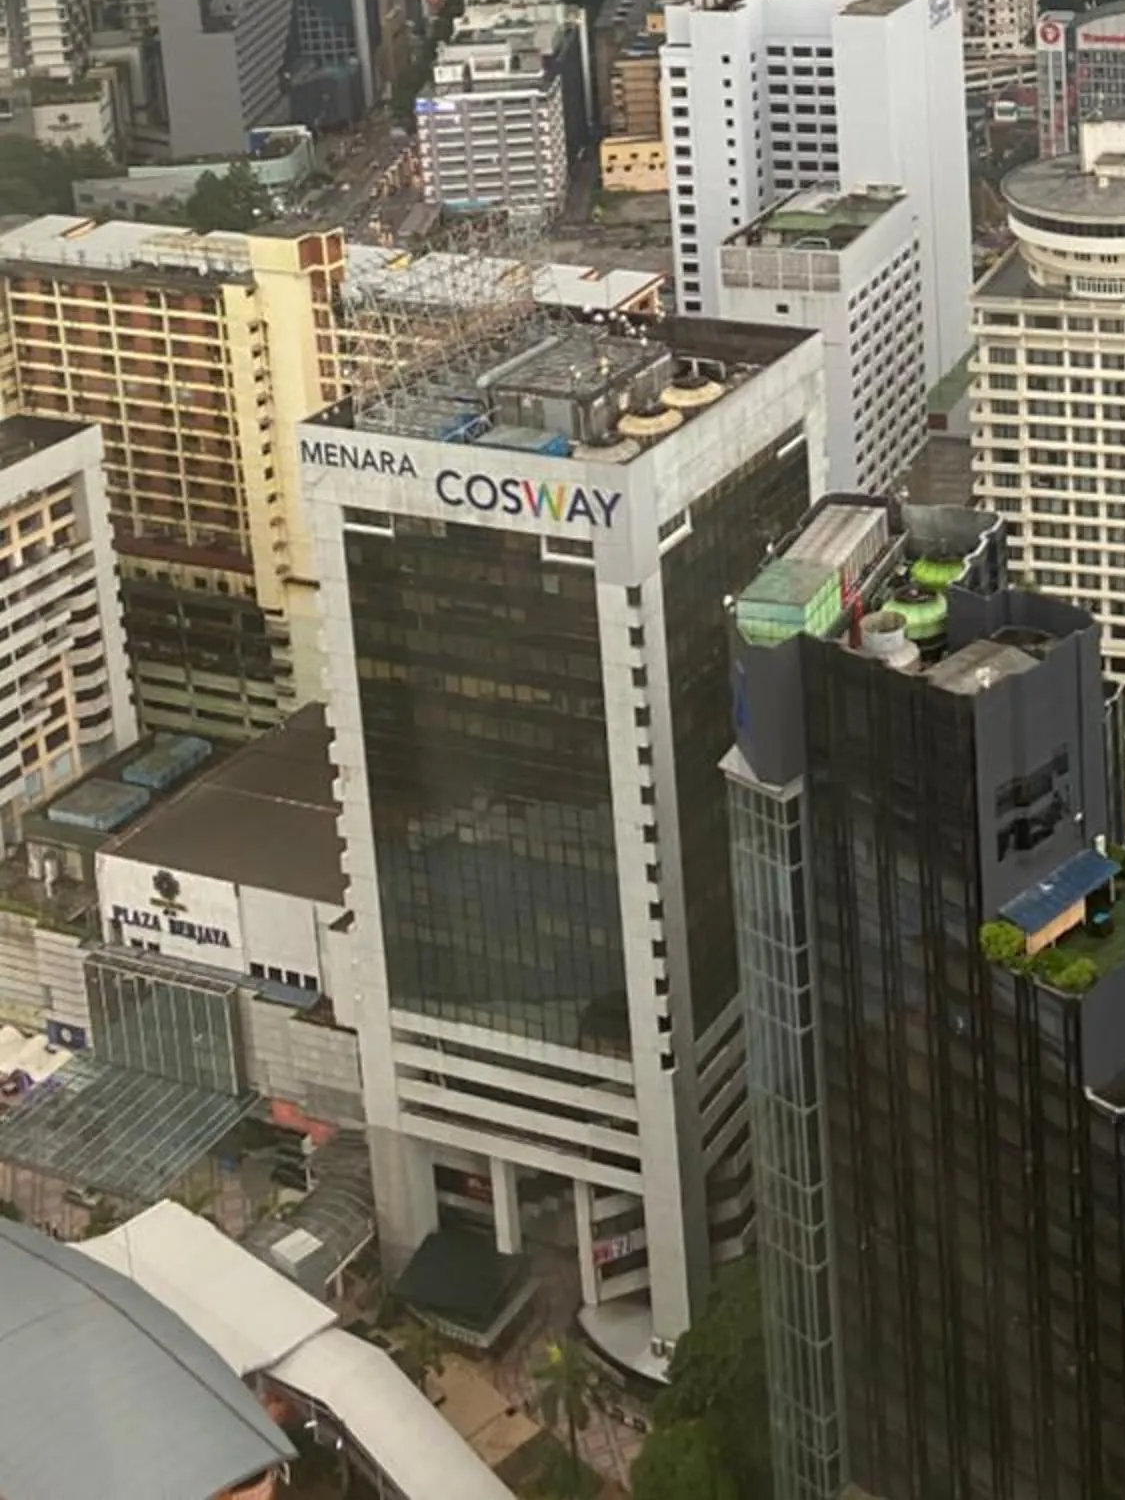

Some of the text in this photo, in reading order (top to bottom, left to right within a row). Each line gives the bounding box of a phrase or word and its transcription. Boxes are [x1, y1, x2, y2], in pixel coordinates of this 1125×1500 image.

[301, 439, 622, 528] MENARA COSWAY
[112, 904, 162, 932] PLAZA
